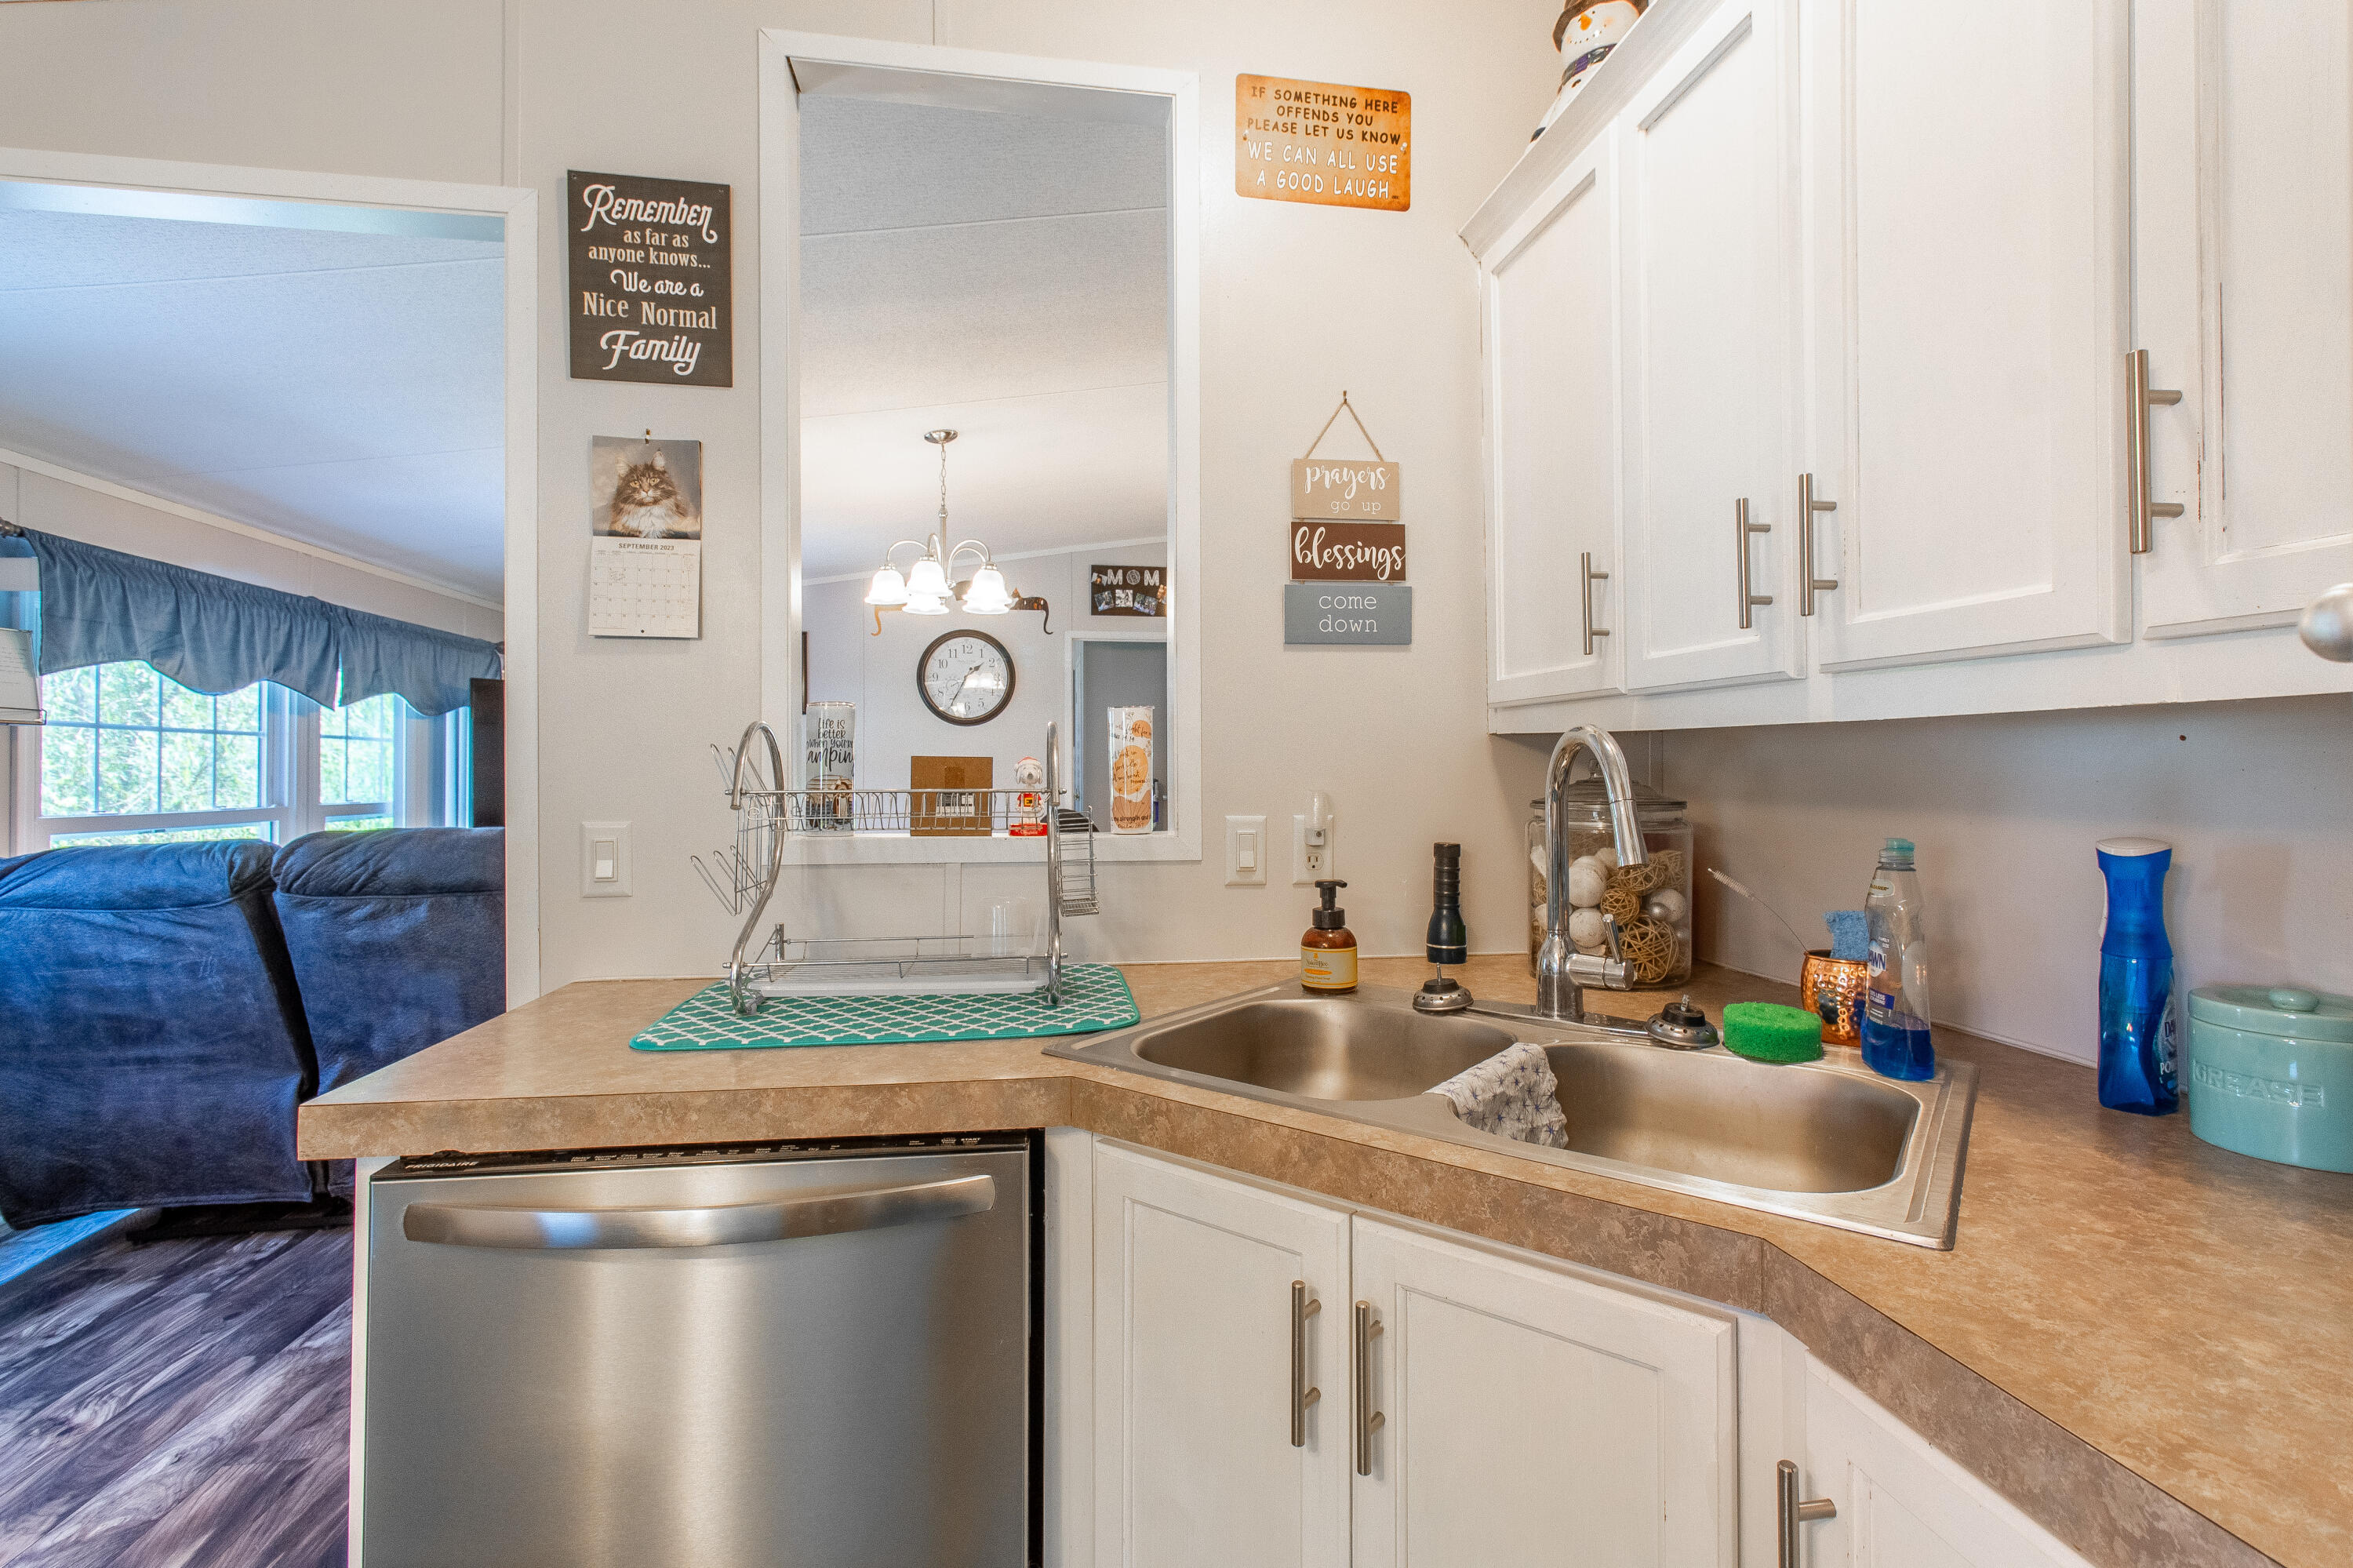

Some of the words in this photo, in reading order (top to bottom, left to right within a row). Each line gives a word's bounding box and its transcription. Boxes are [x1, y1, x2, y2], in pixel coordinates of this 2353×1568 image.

[1251, 86, 1266, 99] IF
[1274, 89, 1357, 108] SOMETHING
[1365, 98, 1398, 114] HERE
[1276, 105, 1339, 122] OFFENDS
[1347, 112, 1373, 126] YOU
[1247, 118, 1297, 134] PLEASE
[1305, 124, 1329, 136] LET
[1337, 128, 1354, 140] US
[1362, 130, 1401, 145] KNOW
[1248, 140, 1272, 162] WE
[1282, 144, 1317, 165] CAN
[1327, 150, 1356, 170] ALL
[1366, 154, 1398, 174] USE
[1257, 169, 1266, 187] A
[1276, 169, 1324, 193] GOOD
[1333, 176, 1389, 199] LAUGH
[624, 230, 641, 244] as
[645, 227, 668, 246] far
[671, 234, 689, 248] as
[588, 246, 645, 264] anyone
[649, 247, 711, 268] knows...
[609, 269, 651, 293] We
[654, 279, 686, 296] are
[690, 282, 704, 297] a
[583, 291, 629, 318] Nice
[641, 301, 718, 329] Normal
[599, 329, 701, 376] Family
[1304, 466, 1391, 500] prayers
[1330, 501, 1350, 514] go
[1361, 501, 1381, 514] up
[1294, 526, 1406, 580] blessings
[1318, 595, 1377, 609] come
[1318, 614, 1378, 632] down
[948, 649, 958, 658] 11
[962, 644, 973, 654] 12
[980, 649, 984, 658] 1
[938, 659, 948, 668] 10
[988, 657, 995, 668] 2
[932, 673, 939, 682] 9
[964, 701, 971, 711] 6
[978, 697, 984, 708] 5
[818, 718, 835, 729] Life
[837, 719, 846, 729] is
[817, 728, 846, 739] better
